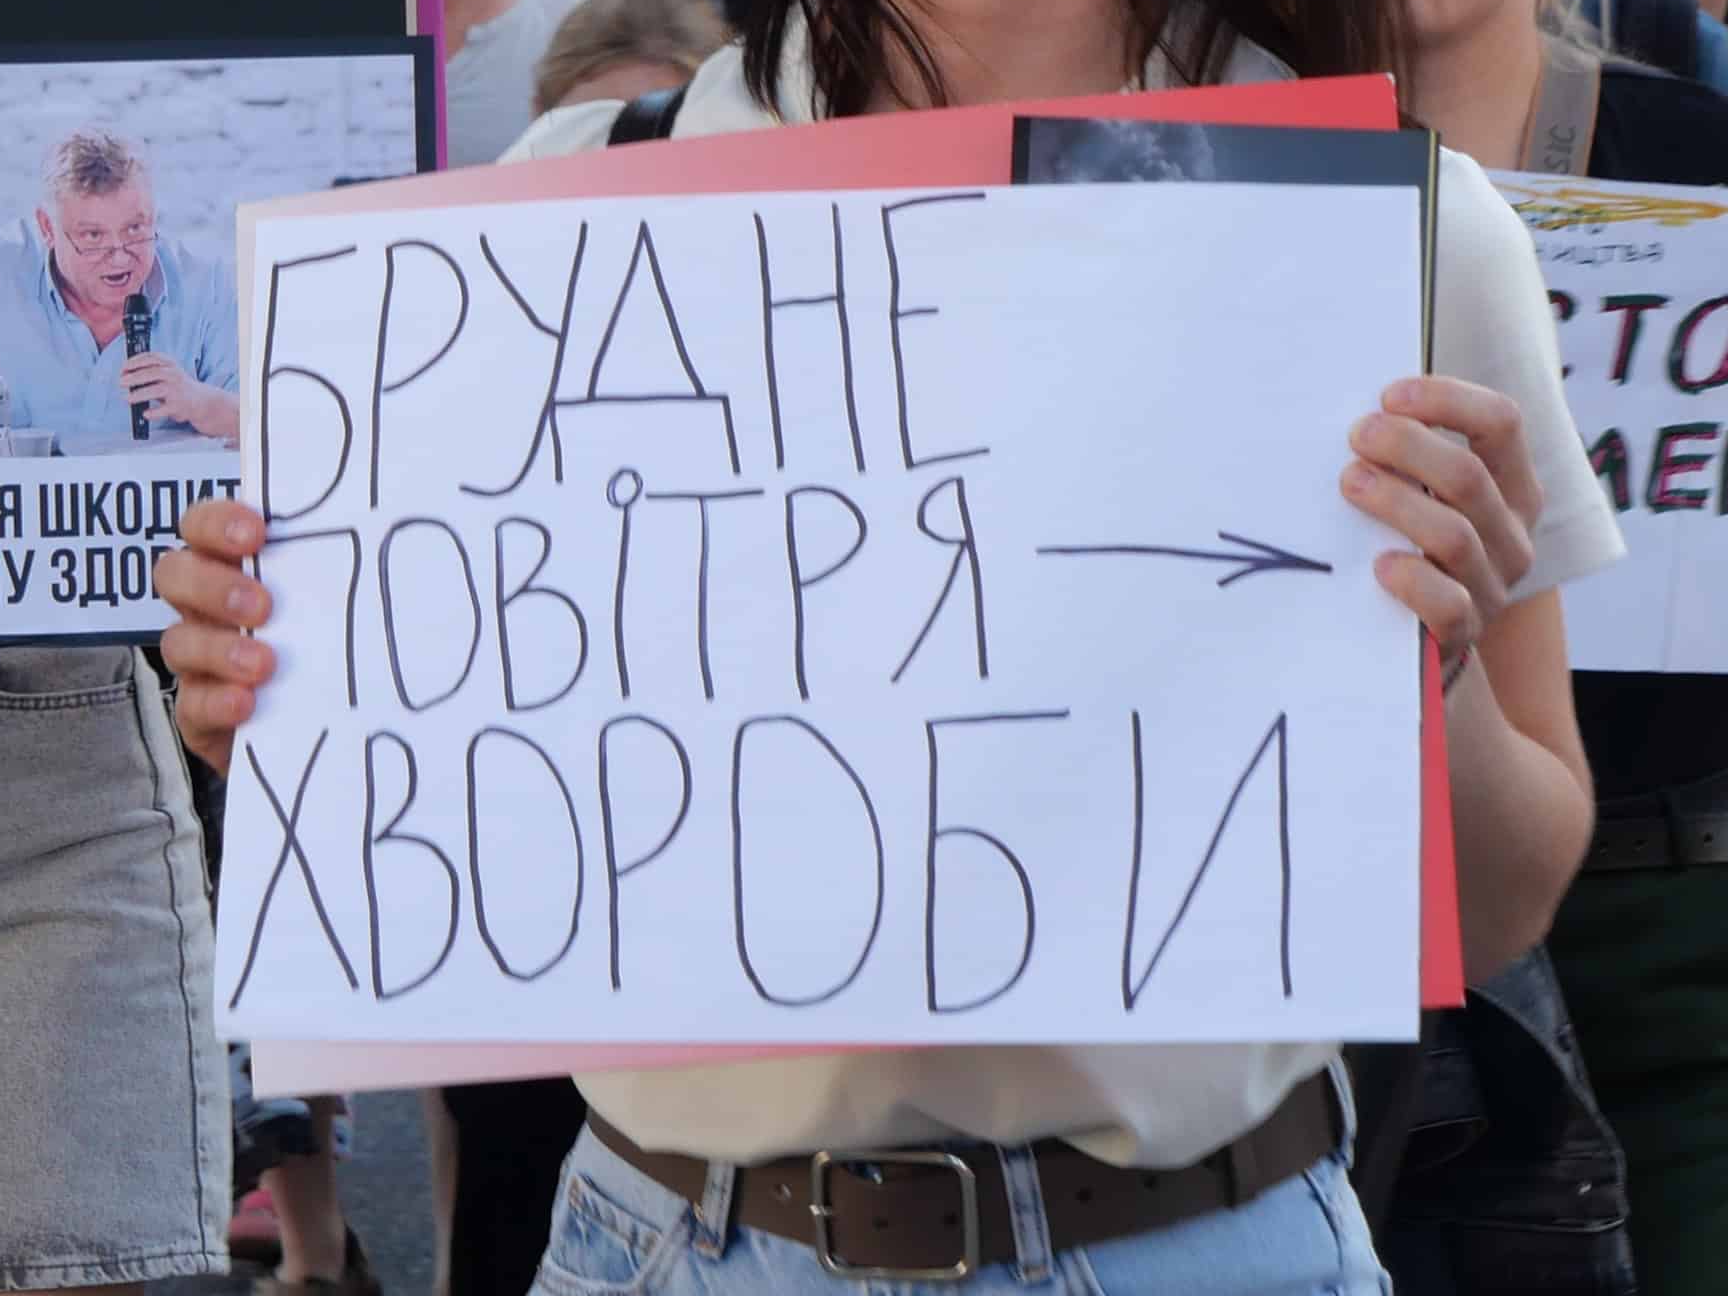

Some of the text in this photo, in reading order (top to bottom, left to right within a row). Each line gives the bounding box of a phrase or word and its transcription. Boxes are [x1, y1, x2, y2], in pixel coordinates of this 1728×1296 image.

[258, 190, 991, 523] БРУДНЕ
[50, 544, 172, 609] ЗДО
[253, 466, 991, 712] ПОВІТРЯ
[228, 709, 1292, 1013] ХВОРОБИ
